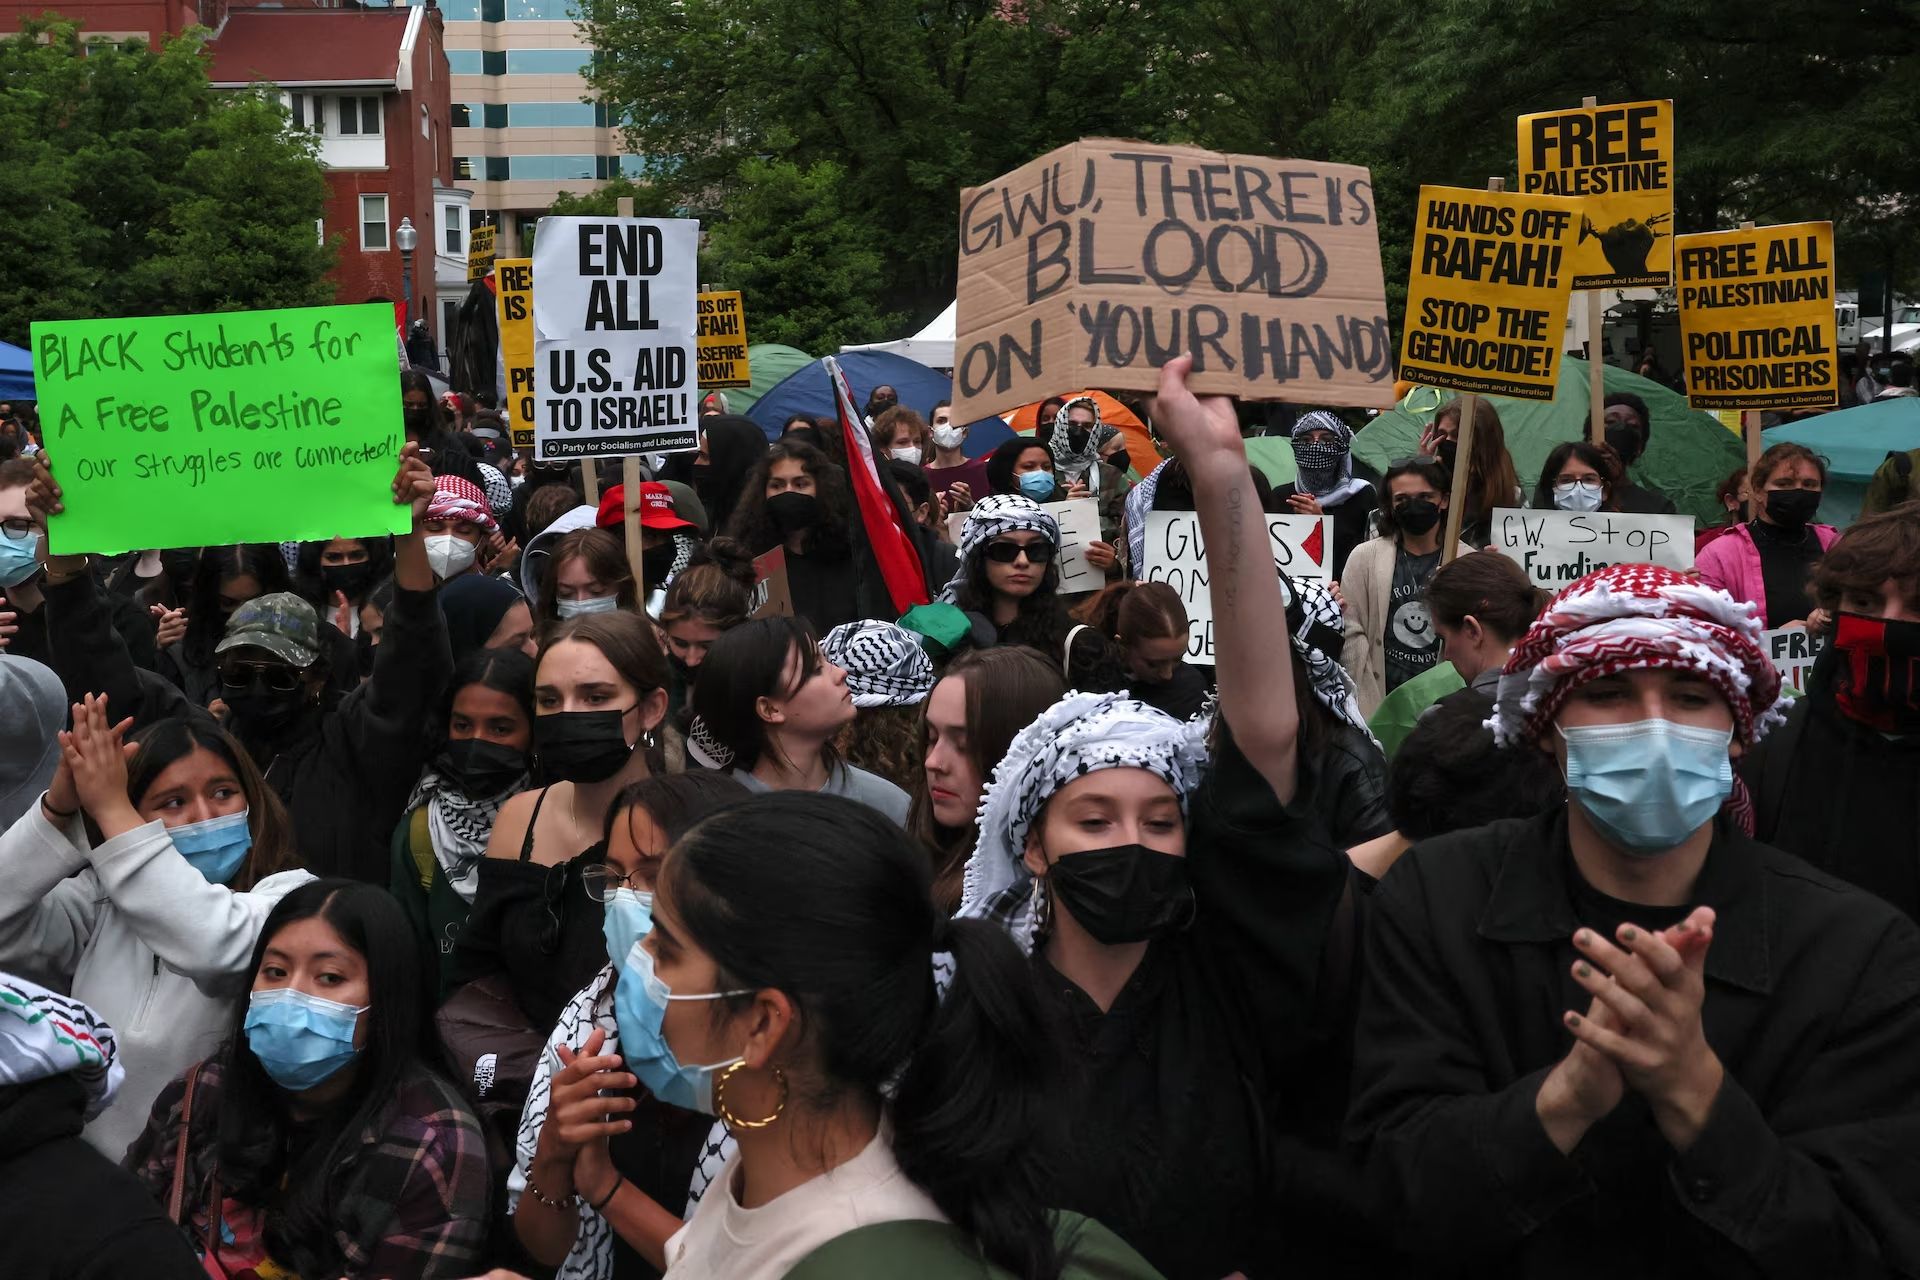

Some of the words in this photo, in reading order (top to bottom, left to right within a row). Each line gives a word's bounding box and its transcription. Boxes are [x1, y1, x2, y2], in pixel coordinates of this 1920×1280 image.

[1530, 106, 1659, 171] FREE
[1524, 161, 1668, 196] PALESTINE
[960, 157, 1103, 256] GWU,
[1111, 153, 1326, 224] THERE
[1325, 176, 1373, 226] IS
[1427, 200, 1516, 238] HANDS
[1521, 208, 1571, 241] OFF
[578, 224, 664, 277] END
[1026, 217, 1328, 305] BLOOD
[1421, 234, 1564, 289] RAFAH!
[1681, 243, 1757, 281] FREE
[1766, 236, 1828, 274] ALL
[1575, 279, 1611, 287] Socialism
[1628, 276, 1667, 284] Liberation
[1683, 275, 1828, 310] PALESTINIAN
[503, 296, 527, 321] IS
[584, 279, 660, 332] ALL
[716, 298, 737, 313] OFF
[1420, 297, 1490, 334] STOP
[1497, 306, 1550, 342] THE
[39, 331, 144, 382] BLACK
[163, 323, 295, 372] Students
[308, 319, 363, 364] for
[958, 318, 1043, 399] ON
[1407, 331, 1554, 378] GENOCIDE!
[1688, 325, 1830, 361] POLITICAL
[549, 348, 623, 395] U.S.
[633, 346, 687, 392] AID
[1418, 373, 1438, 383] Party
[1439, 376, 1451, 384] for
[1451, 378, 1490, 390] Socialism
[1491, 383, 1507, 392] and
[1508, 386, 1550, 397] Liberation
[1691, 360, 1831, 391] PRISONERS
[58, 402, 83, 439] A
[96, 396, 169, 432] Free
[190, 389, 342, 432] Palestine
[546, 399, 584, 433] TO
[590, 393, 688, 432] ISRAEL!
[1704, 399, 1722, 407] Party
[1735, 398, 1772, 406] Socialism
[1791, 395, 1833, 403] Liberation
[253, 449, 283, 470] are
[562, 443, 586, 454] Party
[587, 442, 600, 451] for
[600, 440, 642, 451] Socialism
[642, 439, 655, 448] and
[655, 436, 695, 447] Liberation
[1568, 516, 1670, 560] Stop
[478, 1066, 489, 1097] NORTH
[487, 1066, 495, 1088] FACE
